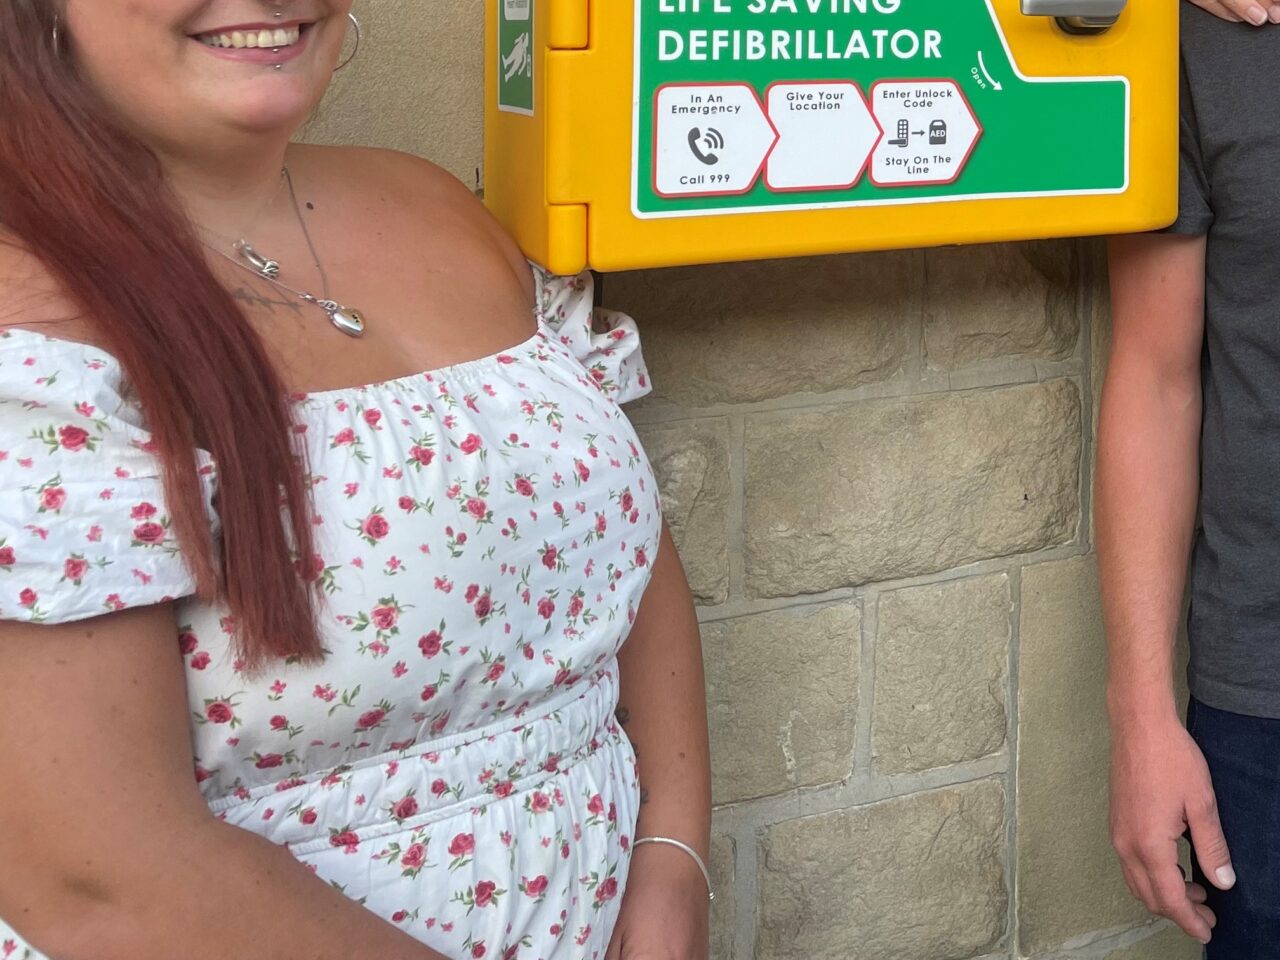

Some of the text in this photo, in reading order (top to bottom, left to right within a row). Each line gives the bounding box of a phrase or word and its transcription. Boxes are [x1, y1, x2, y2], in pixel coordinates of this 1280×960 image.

[658, 29, 942, 61] DEFIBRILLATOR
[786, 92, 844, 101] Give Your
[883, 89, 953, 98] Enter Unlock
[690, 94, 723, 103] In An
[790, 101, 841, 111] Location
[903, 99, 933, 108] Code
[671, 105, 741, 115] Emergency
[930, 129, 946, 138] AED
[885, 155, 951, 166] Stay On The
[908, 166, 929, 175] Line
[680, 174, 731, 185] Call 999
